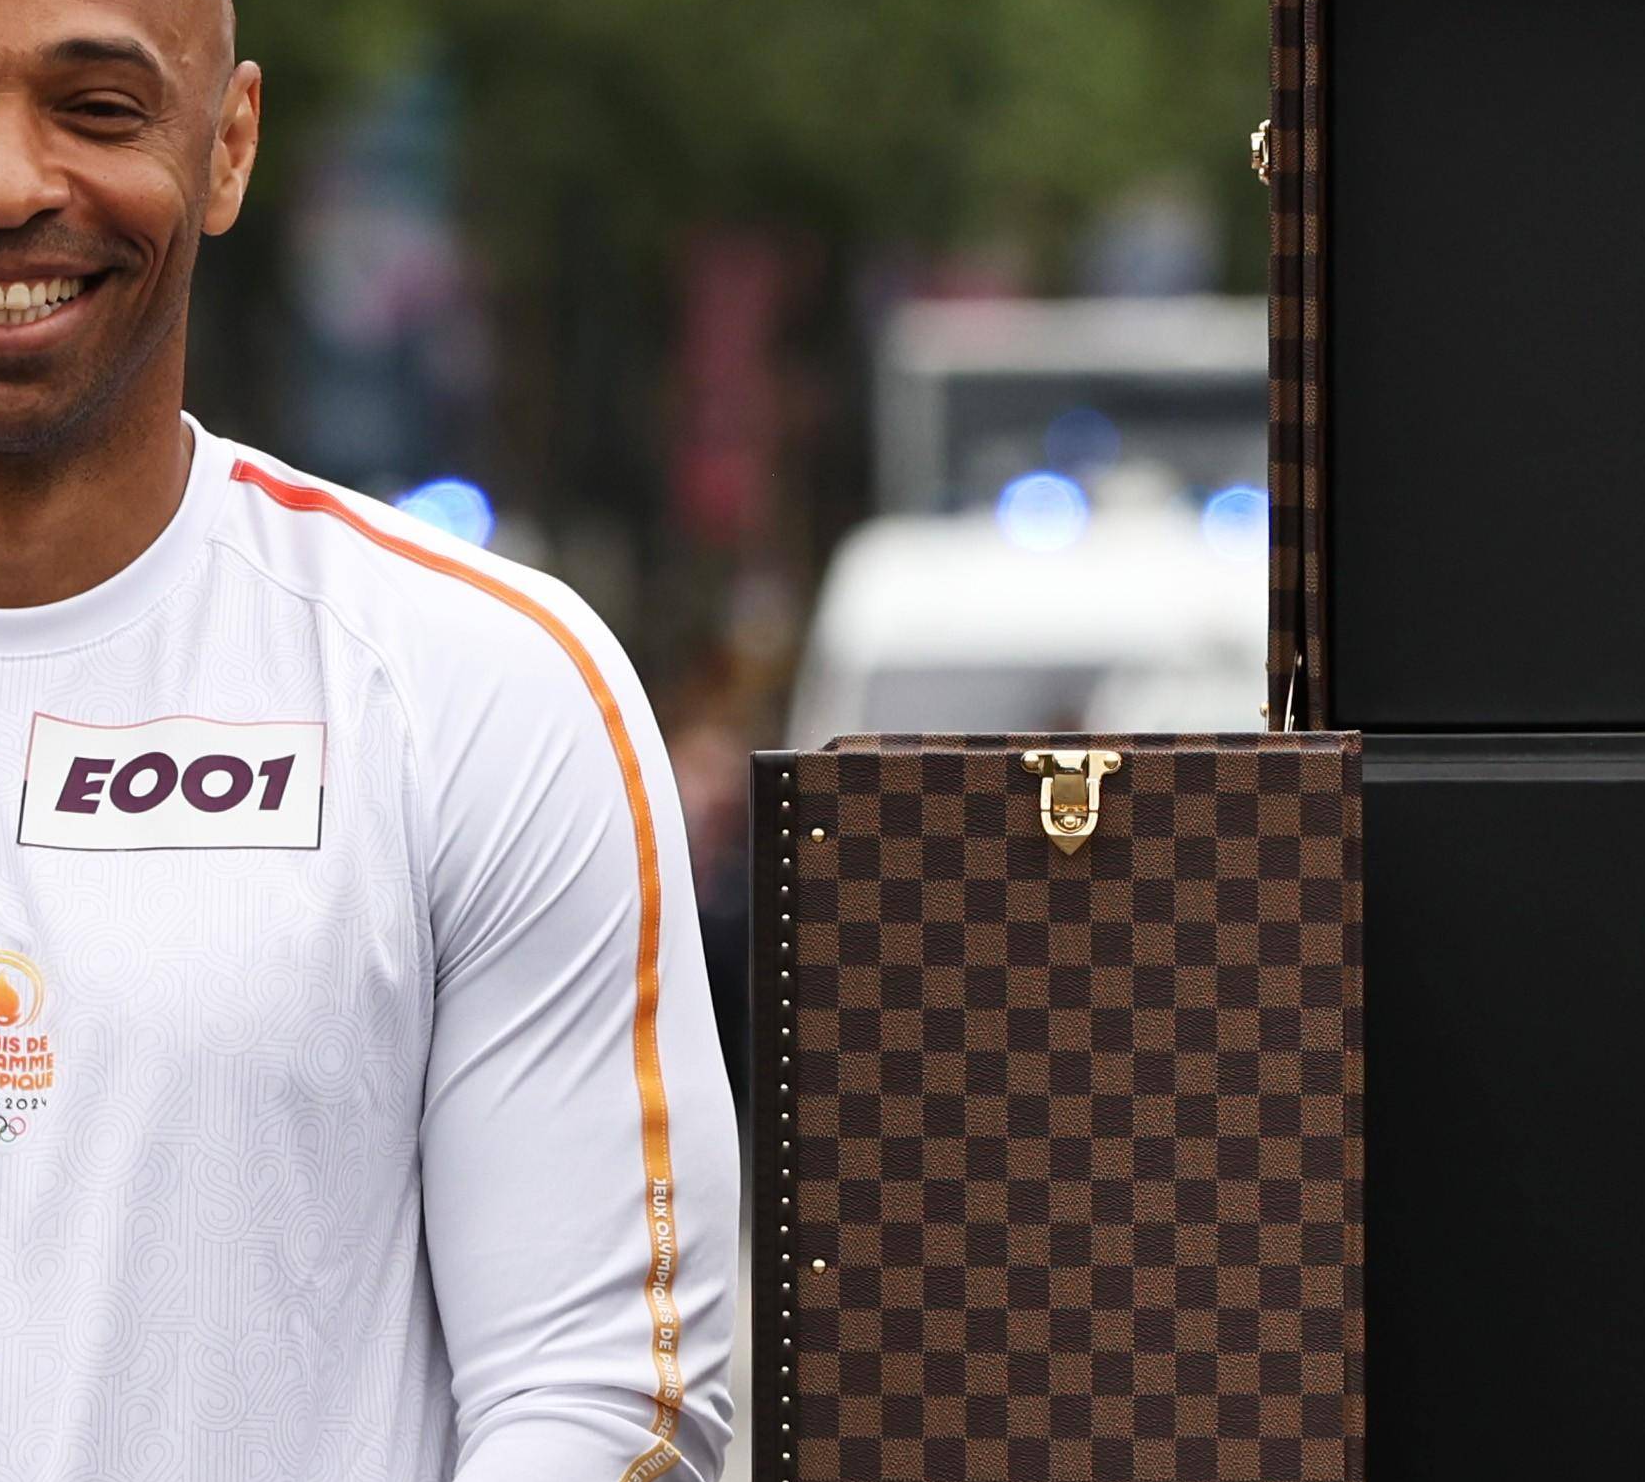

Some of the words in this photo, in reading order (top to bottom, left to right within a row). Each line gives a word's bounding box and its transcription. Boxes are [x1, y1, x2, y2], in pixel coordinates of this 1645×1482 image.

[54, 751, 296, 815] E001
[26, 1034, 48, 1054] DE
[4, 1096, 48, 1110] 2024
[653, 1177, 668, 1218] JEUX
[652, 1221, 674, 1325] OLYMPIQUES
[658, 1327, 673, 1351] DE
[658, 1352, 679, 1400] PARIS
